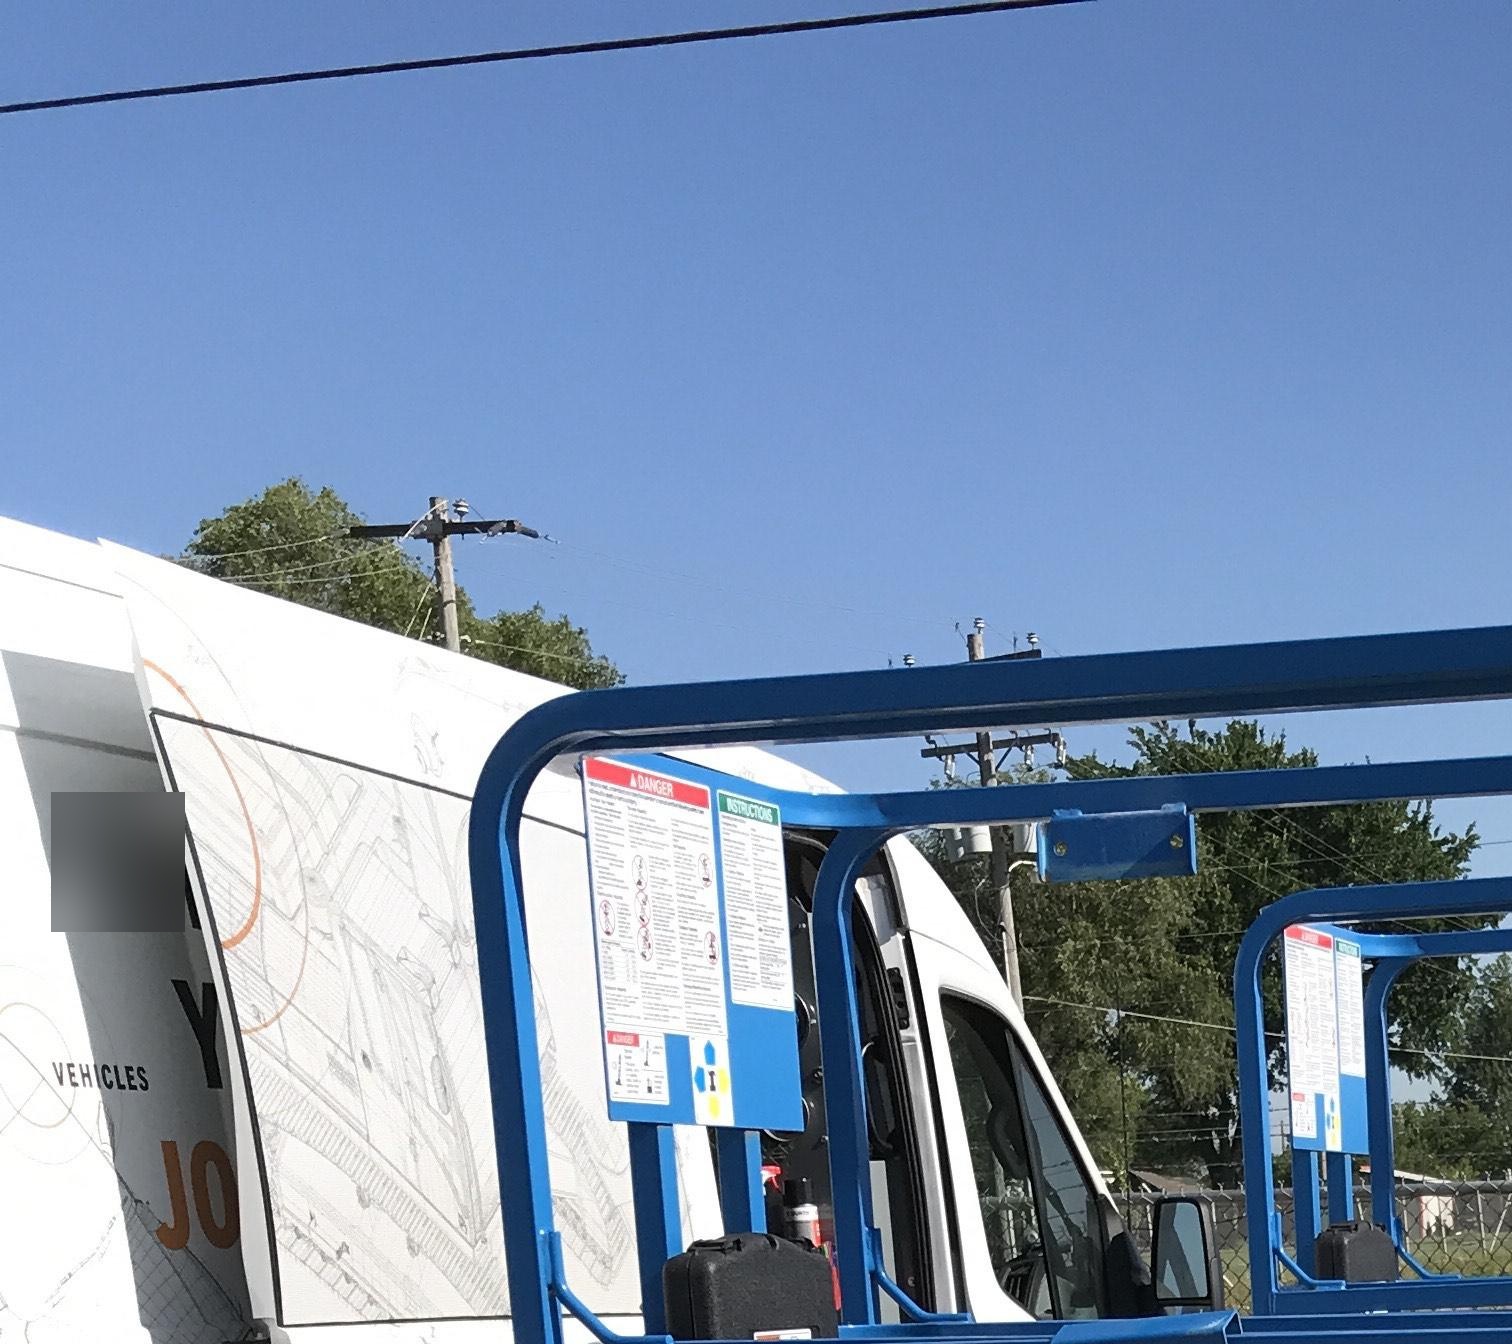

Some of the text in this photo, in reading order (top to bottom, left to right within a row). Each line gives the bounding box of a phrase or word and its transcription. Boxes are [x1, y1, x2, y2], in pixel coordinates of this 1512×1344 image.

[637, 773, 674, 798] DANGER
[726, 797, 773, 823] INSTRUCTIONS
[52, 1061, 150, 1092] VEHICLES
[155, 1140, 241, 1251] JO
